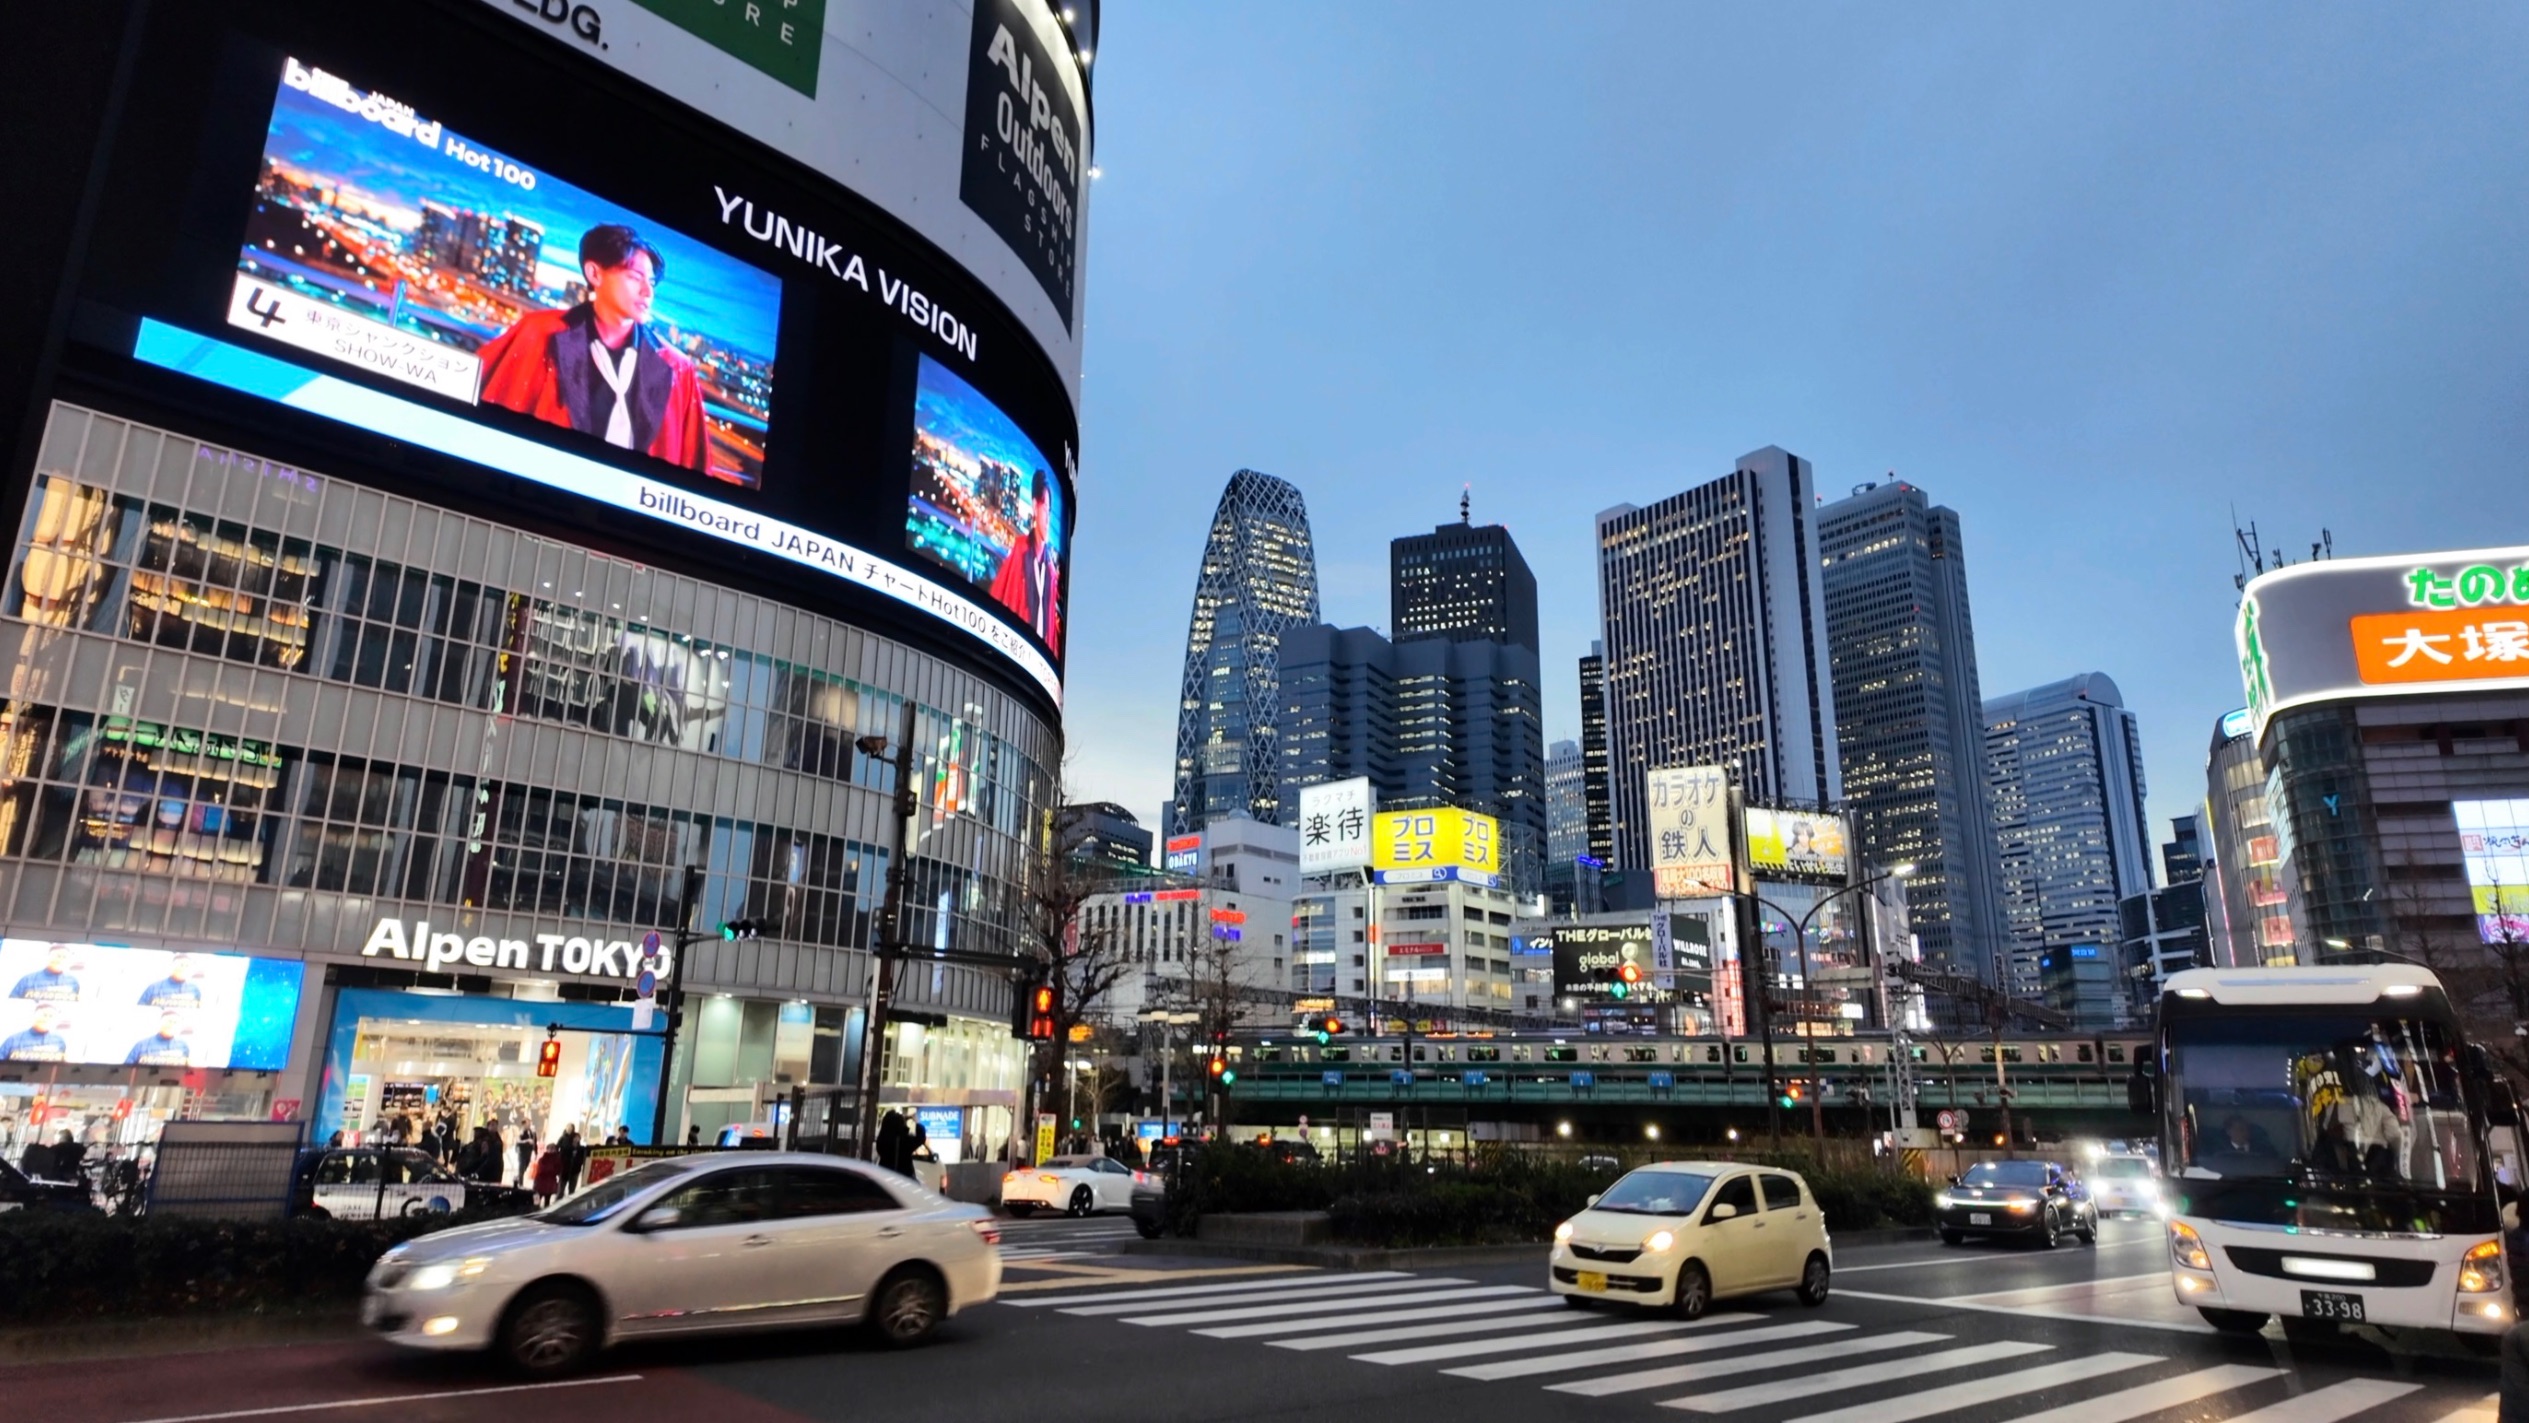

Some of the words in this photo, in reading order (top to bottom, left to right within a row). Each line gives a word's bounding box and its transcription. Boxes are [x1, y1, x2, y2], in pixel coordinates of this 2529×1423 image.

[283, 56, 442, 149] billboard
[368, 90, 415, 118] JAPAN
[987, 23, 1075, 186] Alpen
[997, 91, 1072, 239] Outdoors
[981, 134, 1071, 269] FLAGSHIP
[713, 185, 870, 294] YUNIKA
[877, 269, 978, 362] VISION
[1024, 214, 1070, 298] STORE
[246, 287, 287, 328] 4
[639, 486, 761, 541] billboard
[771, 531, 855, 572] JAPAN
[1653, 773, 1720, 808] カラオケ
[1305, 806, 1365, 847] 楽待
[1392, 815, 1434, 839] プロ
[1462, 816, 1489, 842] プロ
[1680, 809, 1694, 827] の
[1393, 841, 1434, 862] ミス
[1463, 842, 1489, 866] ミス
[1661, 829, 1717, 860] 鉄人
[362, 918, 529, 972] Alpen
[537, 934, 672, 981] TOKYO
[1579, 951, 1619, 973] global
[920, 1111, 960, 1122] SUBNADE
[2313, 1298, 2363, 1320] 33-98
